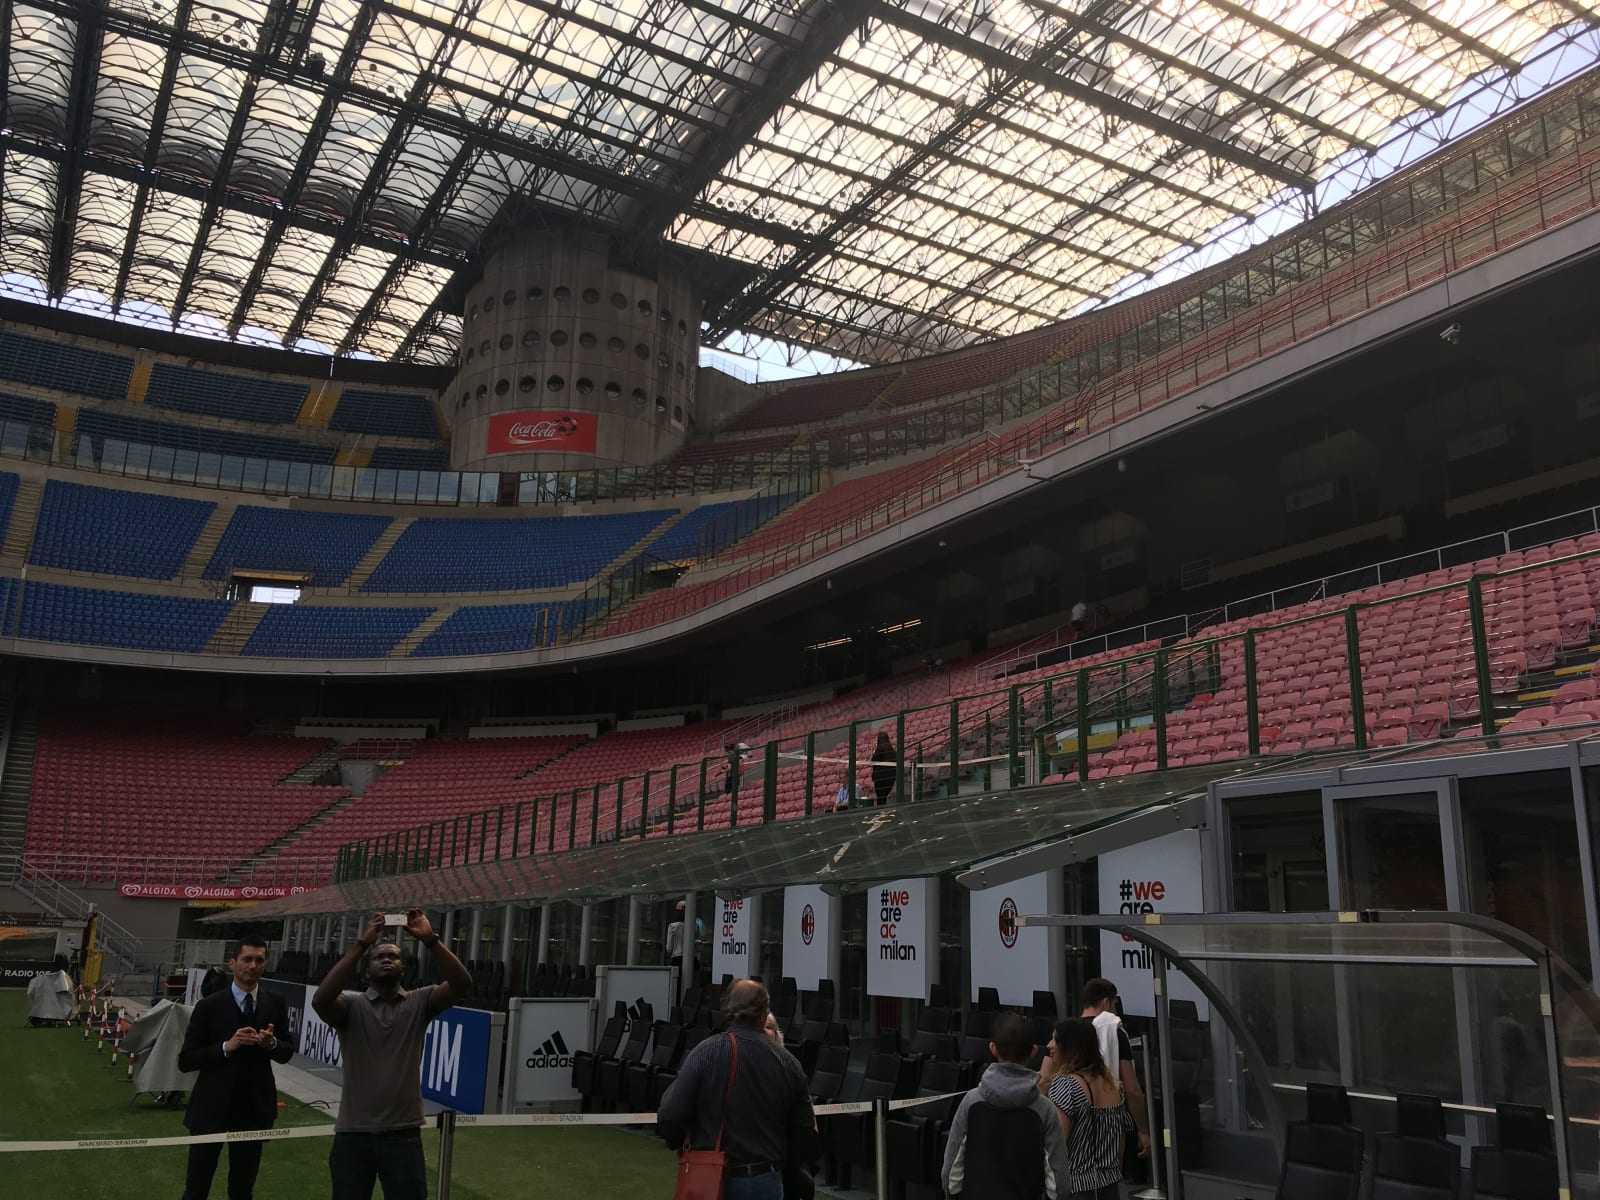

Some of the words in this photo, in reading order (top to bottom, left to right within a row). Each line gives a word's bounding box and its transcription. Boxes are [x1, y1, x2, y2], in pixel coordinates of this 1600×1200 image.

[142, 887, 176, 896] ALGIDA
[202, 888, 234, 897] ALGIDA
[257, 888, 285, 896] ALGIDA
[880, 889, 909, 906] #we
[1120, 880, 1165, 901] #we
[723, 911, 738, 924] are
[880, 907, 902, 922] are
[722, 925, 734, 937] ac
[880, 923, 897, 939] ac
[721, 938, 747, 955] milan
[880, 940, 916, 961] milan
[4, 969, 34, 977] RADIO
[304, 1020, 341, 1066] BANCO
[526, 1055, 576, 1069] adidas
[559, 1114, 583, 1122] STADIUM
